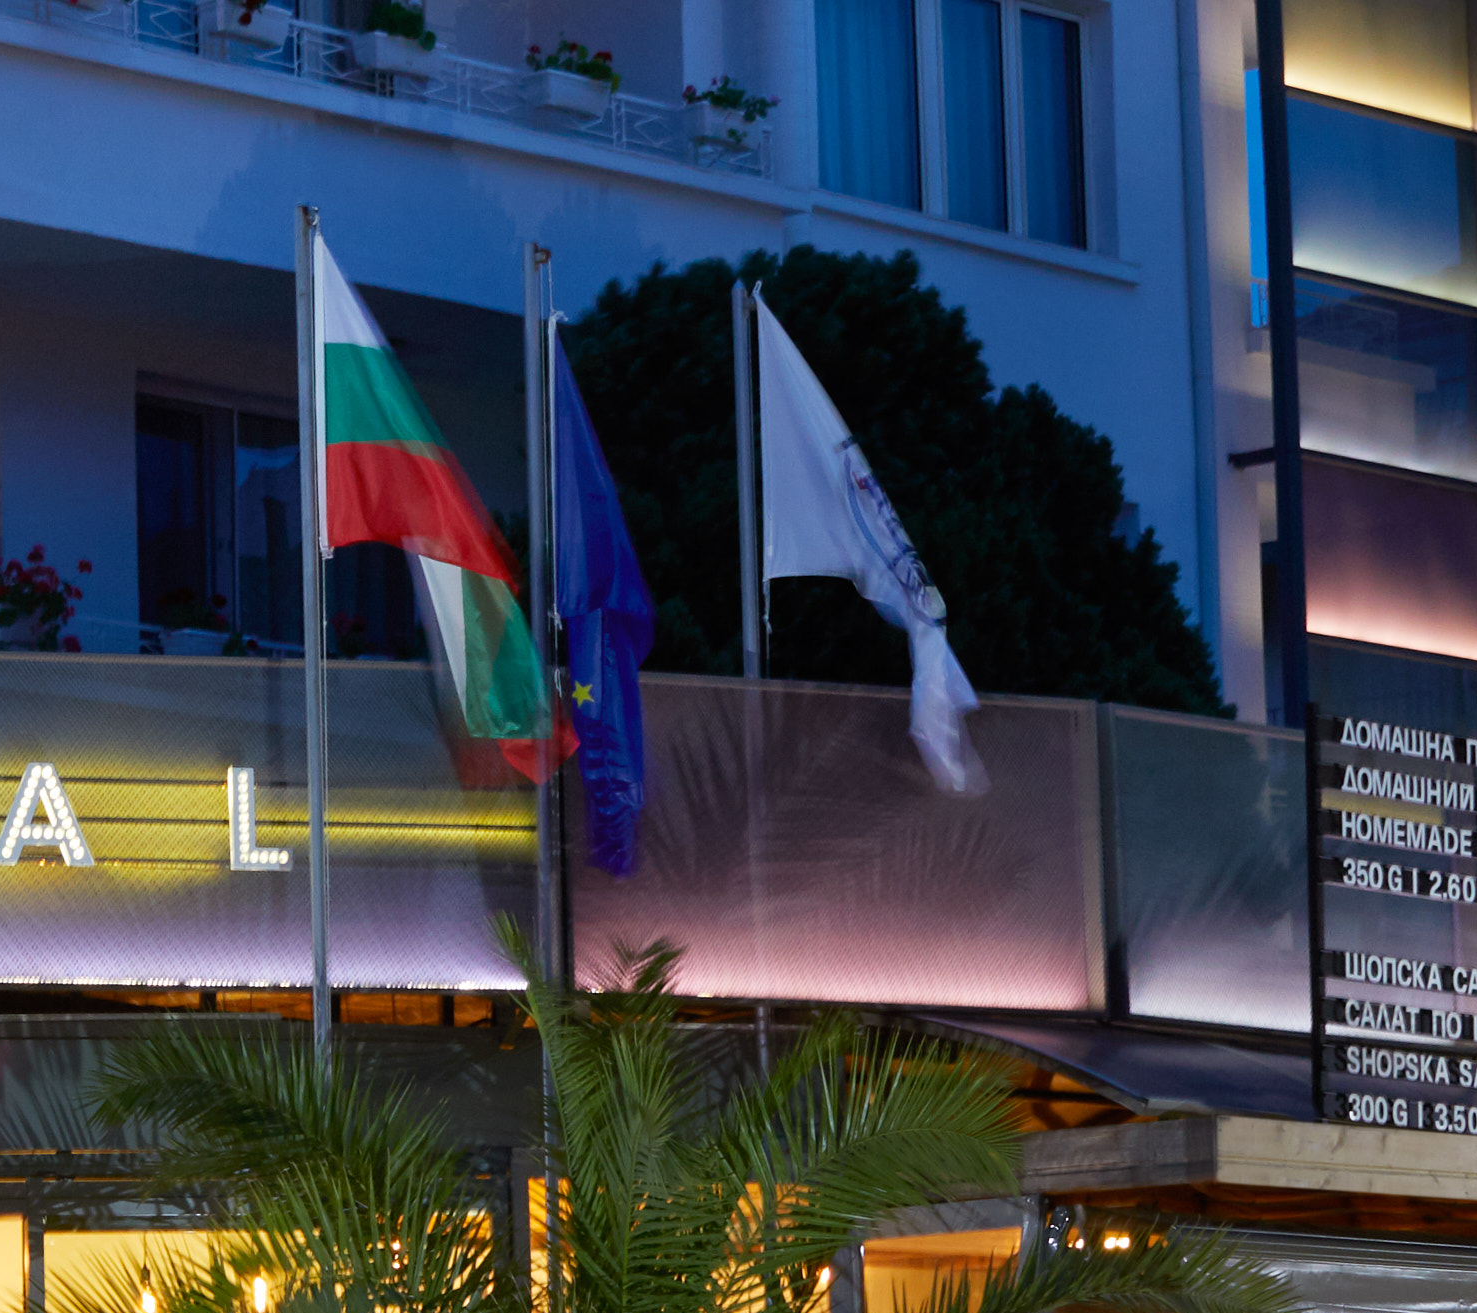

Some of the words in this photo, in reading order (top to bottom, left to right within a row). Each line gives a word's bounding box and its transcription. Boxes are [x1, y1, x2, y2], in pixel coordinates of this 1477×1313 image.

[1340, 717, 1455, 762] ДОМАШНА
[1341, 764, 1474, 812] ДОМАШНИЙ
[1341, 813, 1471, 856] HOMEMADE
[1343, 858, 1383, 890] 350
[1345, 952, 1441, 990] ШОПСКА
[1345, 999, 1419, 1031] САЛАТ
[1431, 1010, 1462, 1038] ПО
[1347, 1048, 1450, 1084] SHOPSKA
[1349, 1094, 1388, 1124] 300
